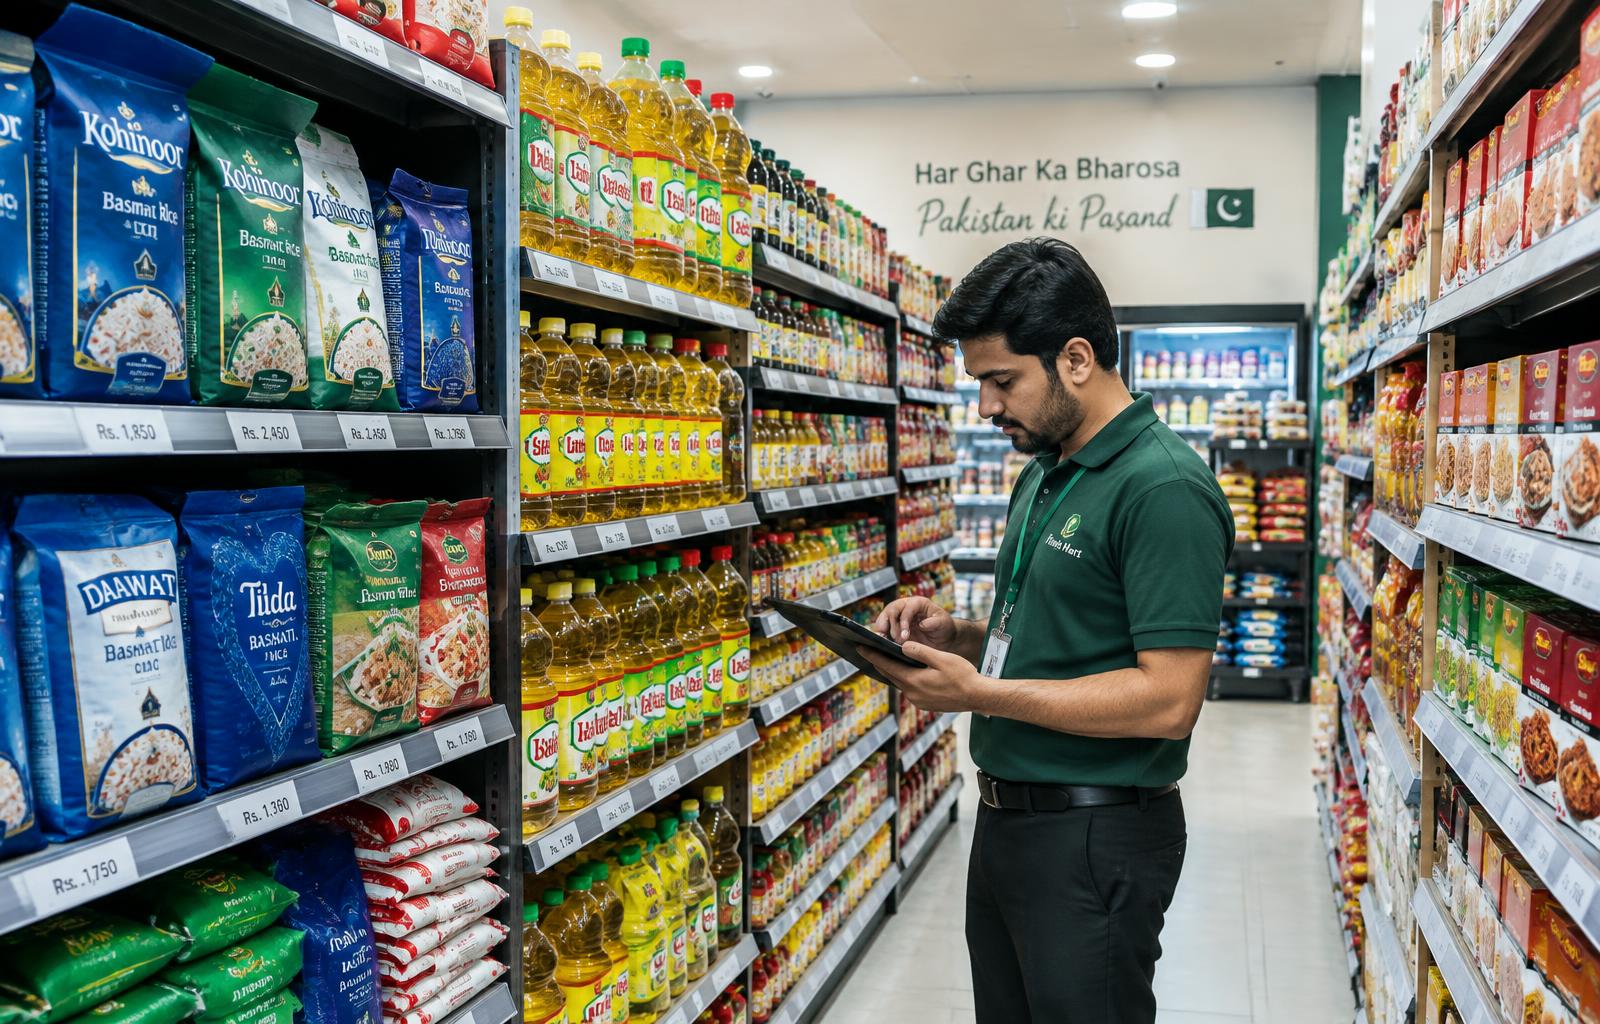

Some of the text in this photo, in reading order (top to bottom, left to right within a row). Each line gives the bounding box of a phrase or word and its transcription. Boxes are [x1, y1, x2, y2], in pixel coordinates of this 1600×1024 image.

[79, 109, 184, 169] Kohinoor
[216, 157, 301, 206] Kohinoor
[915, 156, 1180, 184] Har Ghar Ka Bharosa
[918, 195, 1035, 237] Pakistan
[1043, 195, 1067, 230] ki
[96, 423, 120, 440] Rs.
[242, 426, 260, 440] Rs.
[82, 573, 177, 610] DAAWAT
[239, 581, 297, 618] Tilda
[242, 811, 262, 825] Rs.
